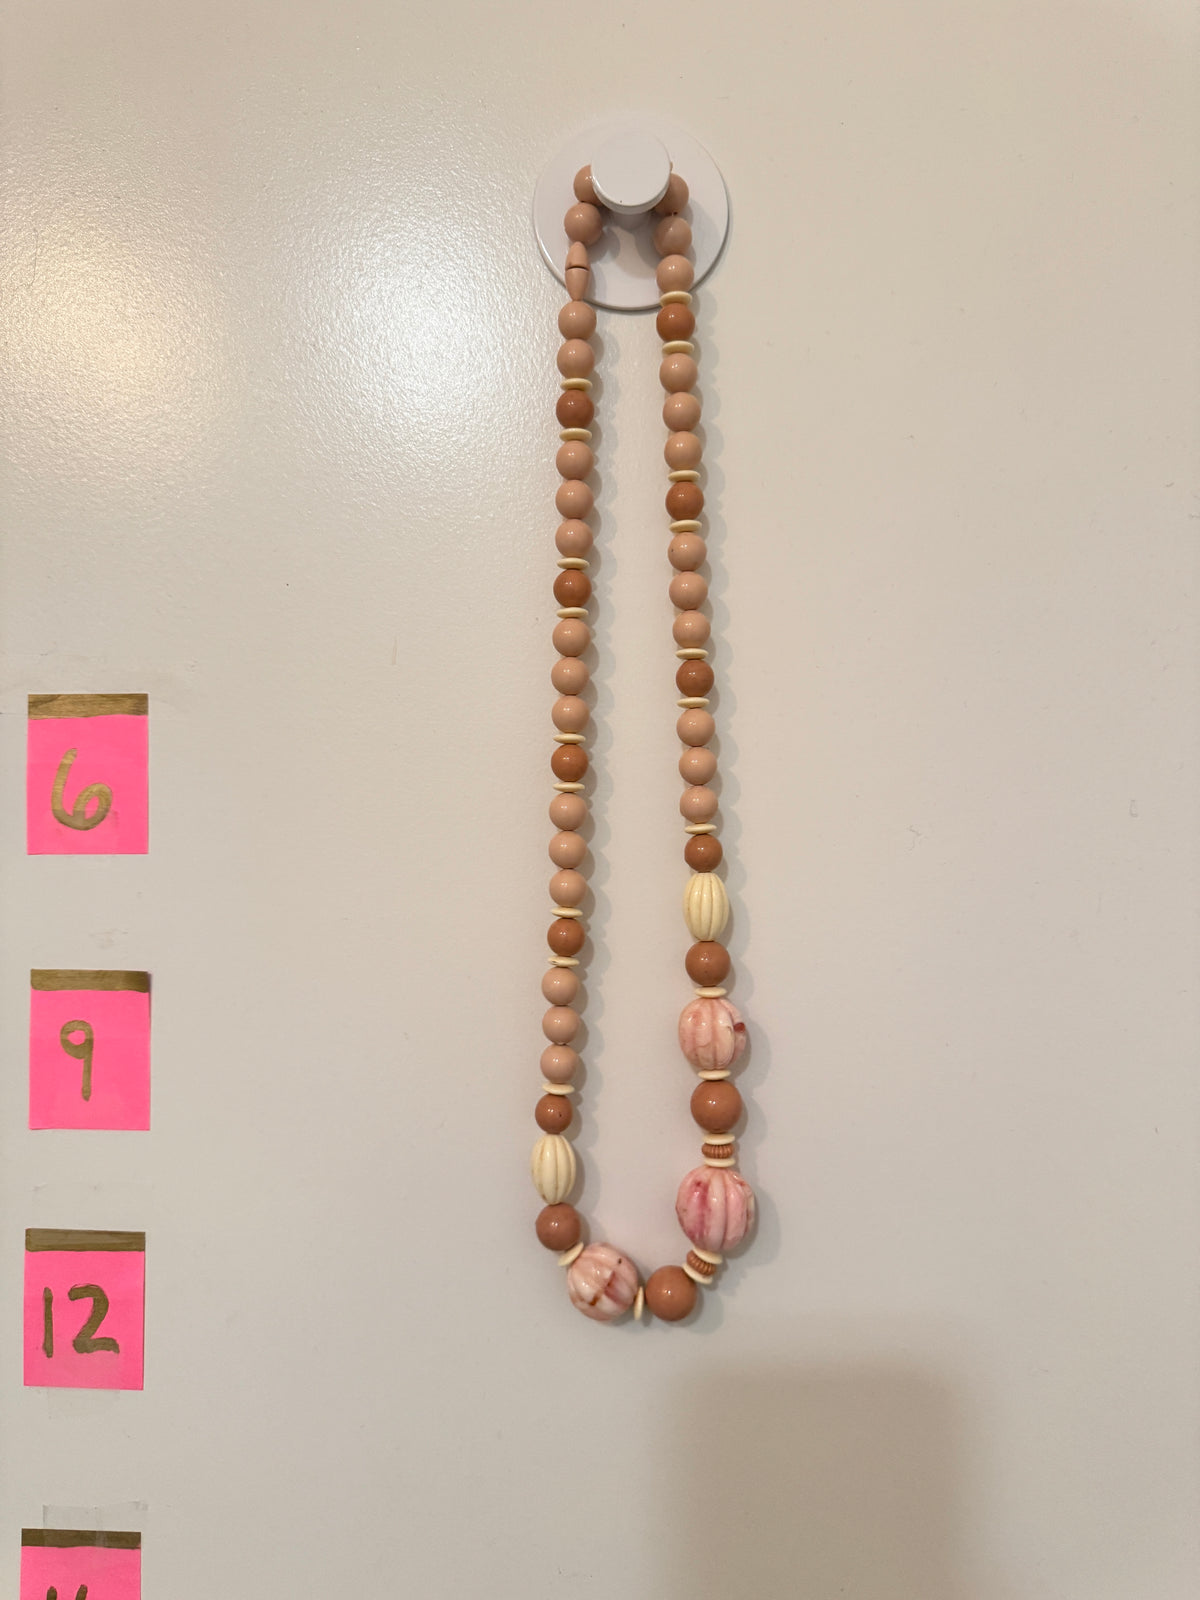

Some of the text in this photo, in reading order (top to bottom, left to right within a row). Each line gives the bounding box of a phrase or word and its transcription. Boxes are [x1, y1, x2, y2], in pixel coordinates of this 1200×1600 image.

[51, 748, 113, 831] 6
[60, 1019, 94, 1102] 9
[42, 1283, 120, 1358] 12
